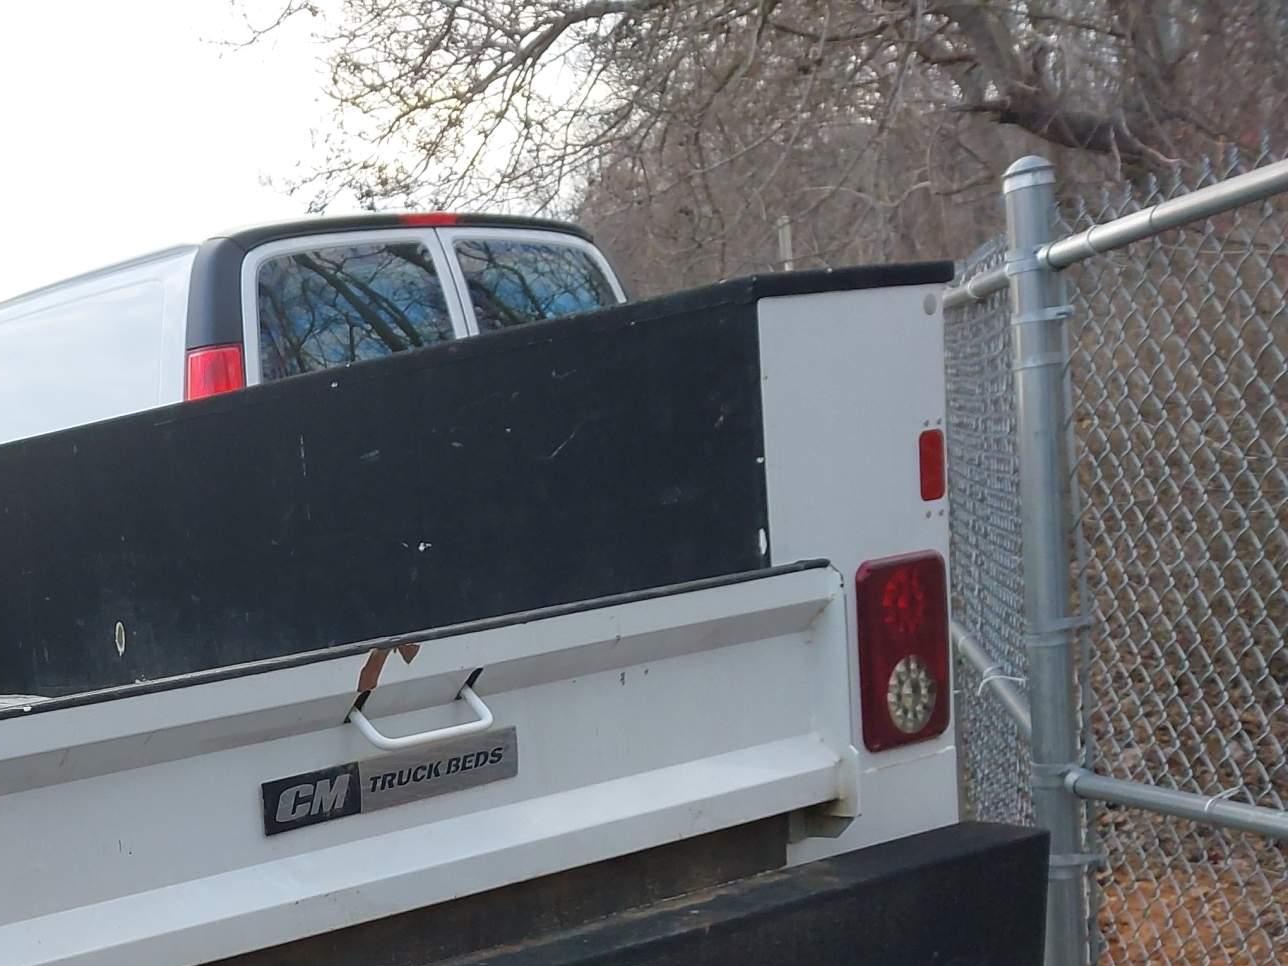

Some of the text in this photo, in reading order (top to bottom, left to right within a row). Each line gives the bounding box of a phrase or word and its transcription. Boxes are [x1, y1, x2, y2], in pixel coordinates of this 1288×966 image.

[275, 747, 504, 823] CM TRUCK BEDS
